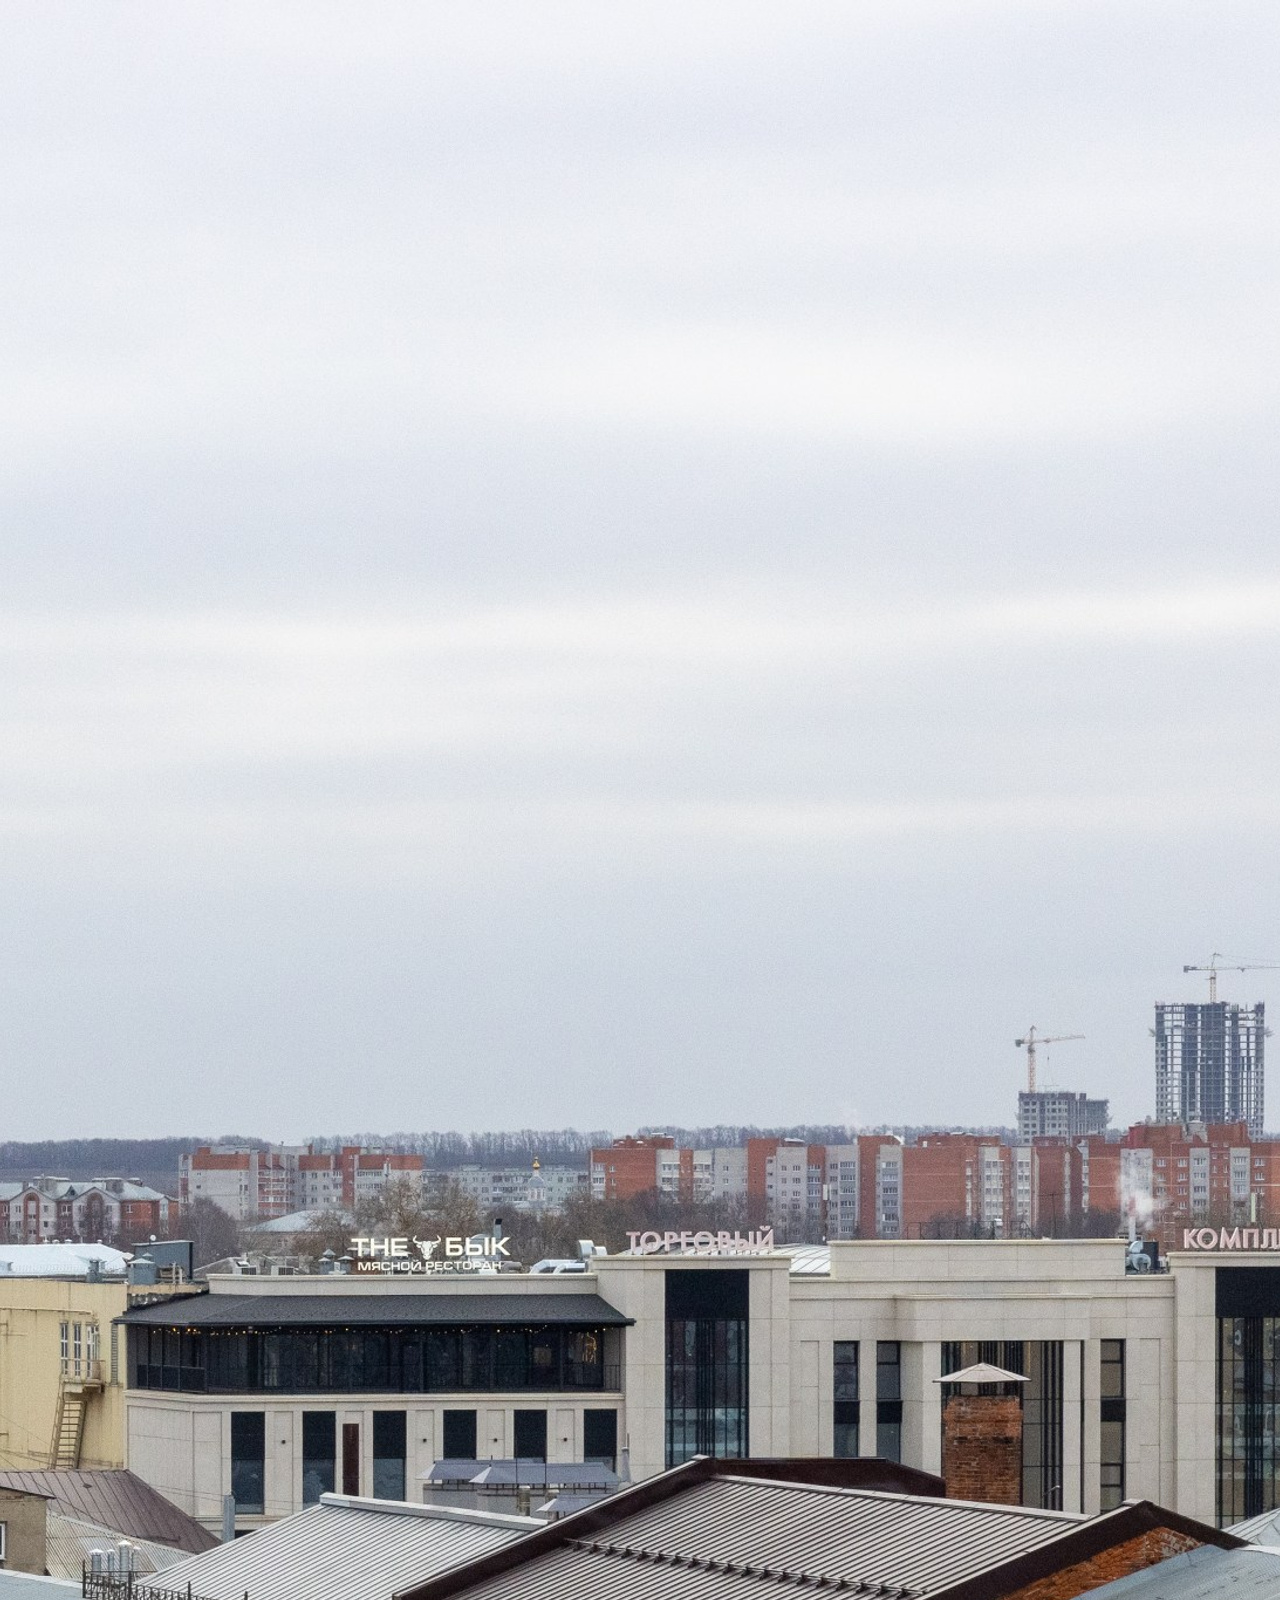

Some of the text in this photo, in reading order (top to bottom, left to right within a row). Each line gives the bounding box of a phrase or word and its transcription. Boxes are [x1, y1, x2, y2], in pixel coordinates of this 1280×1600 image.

[350, 1236, 511, 1257] THE БЫК
[625, 1225, 775, 1252] ТОРГОВЫЙ
[1183, 1226, 1280, 1250] КОМПЛ
[357, 1259, 502, 1271] МЯСНОЙ РЕСТОРАН
